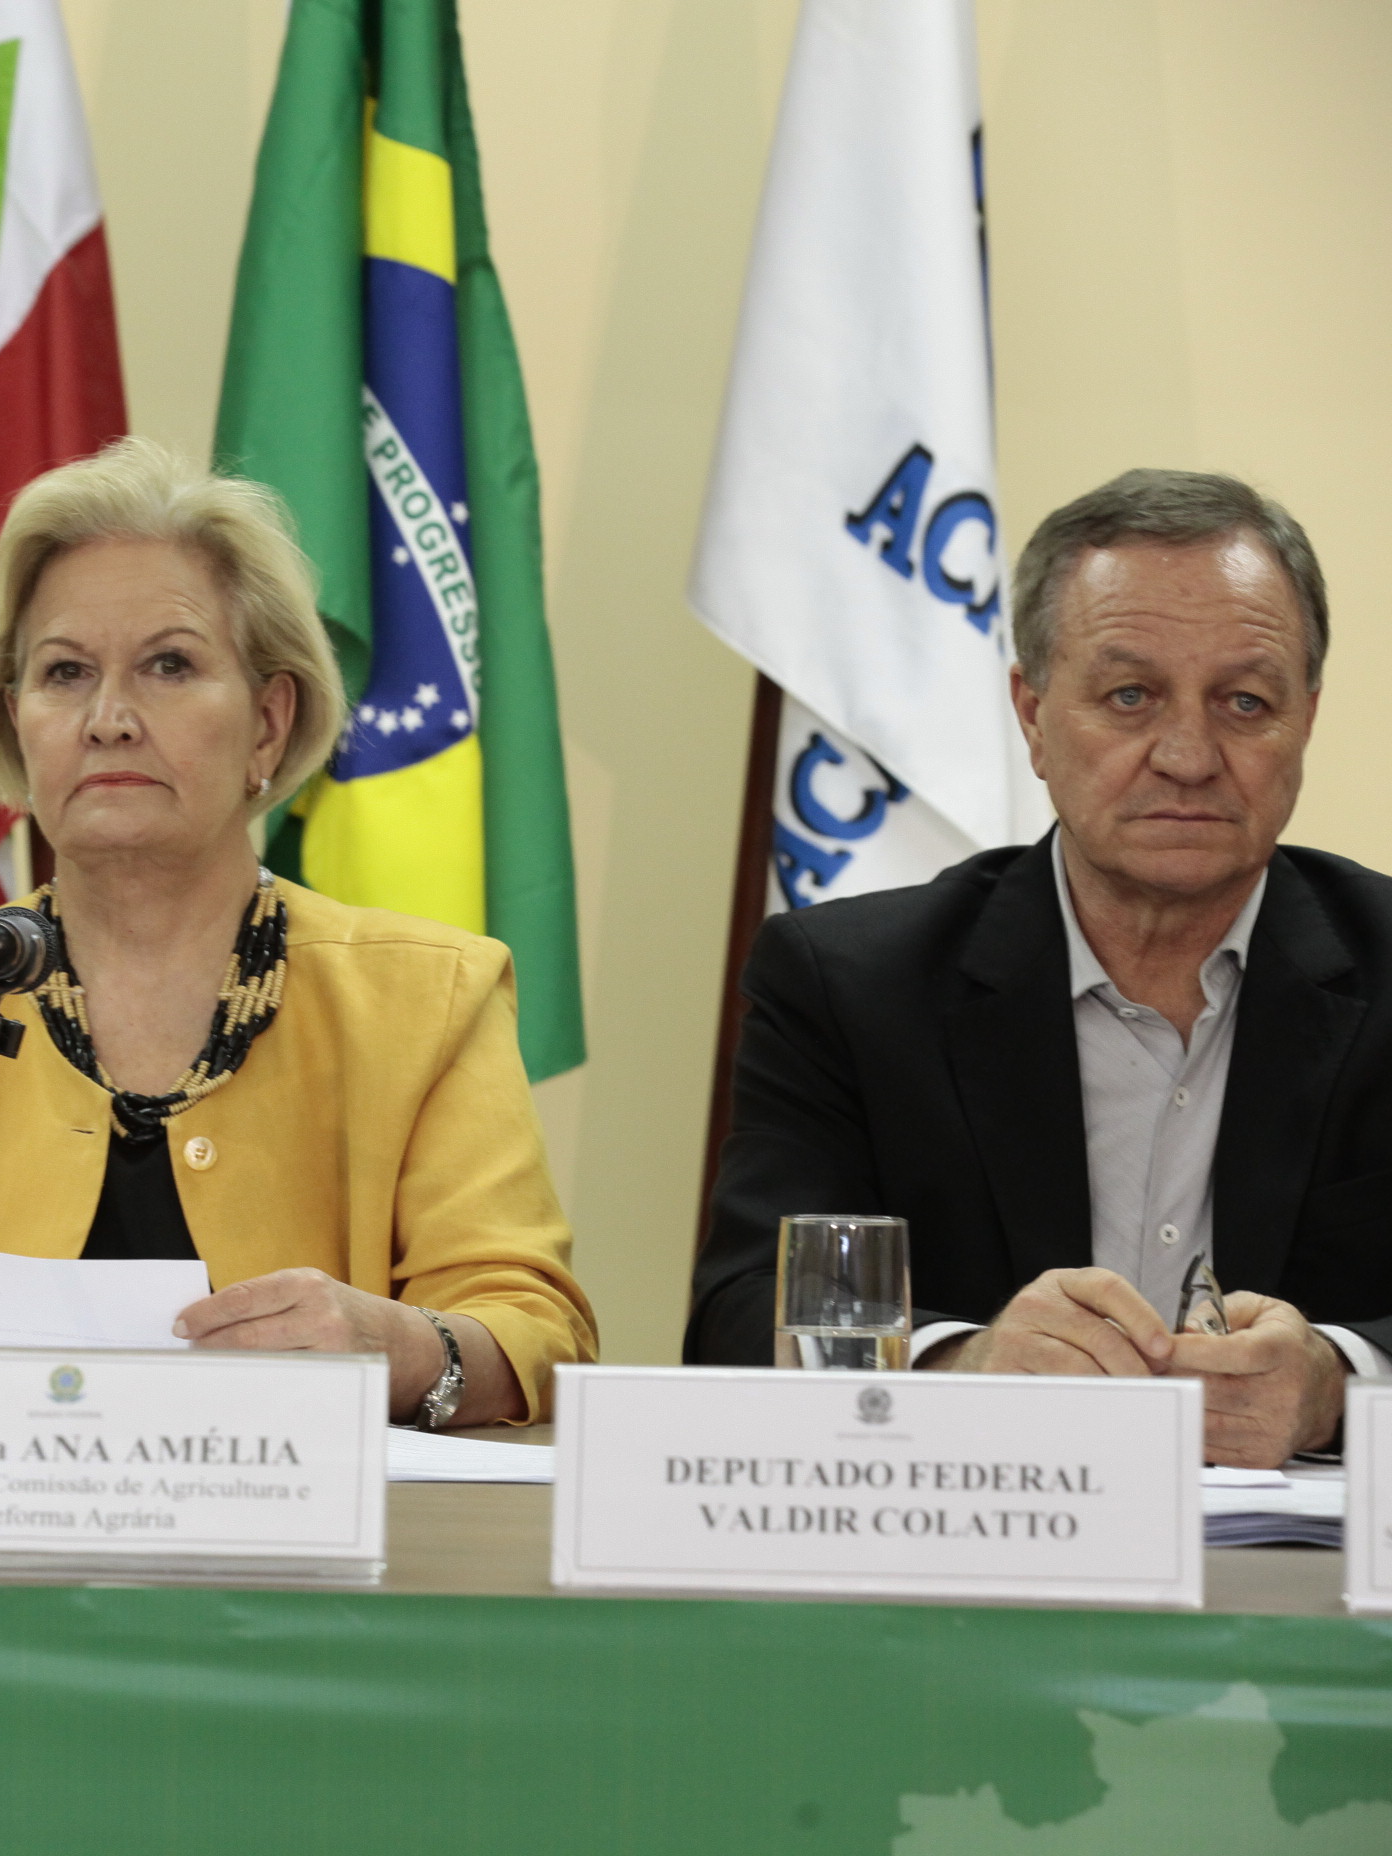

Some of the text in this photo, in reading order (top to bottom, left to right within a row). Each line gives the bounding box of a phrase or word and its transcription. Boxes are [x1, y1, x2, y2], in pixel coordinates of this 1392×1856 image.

[772, 731, 911, 909] AC
[20, 1434, 111, 1463] ANA
[125, 1427, 301, 1466] AMÉLIA
[114, 1477, 144, 1496] de
[150, 1475, 291, 1501] Agricultura
[296, 1485, 311, 1501] e
[665, 1456, 1103, 1494] DEPUTADO FEDERAL
[83, 1507, 176, 1533] Agrária
[699, 1503, 1078, 1540] VALDIR COLATTO
